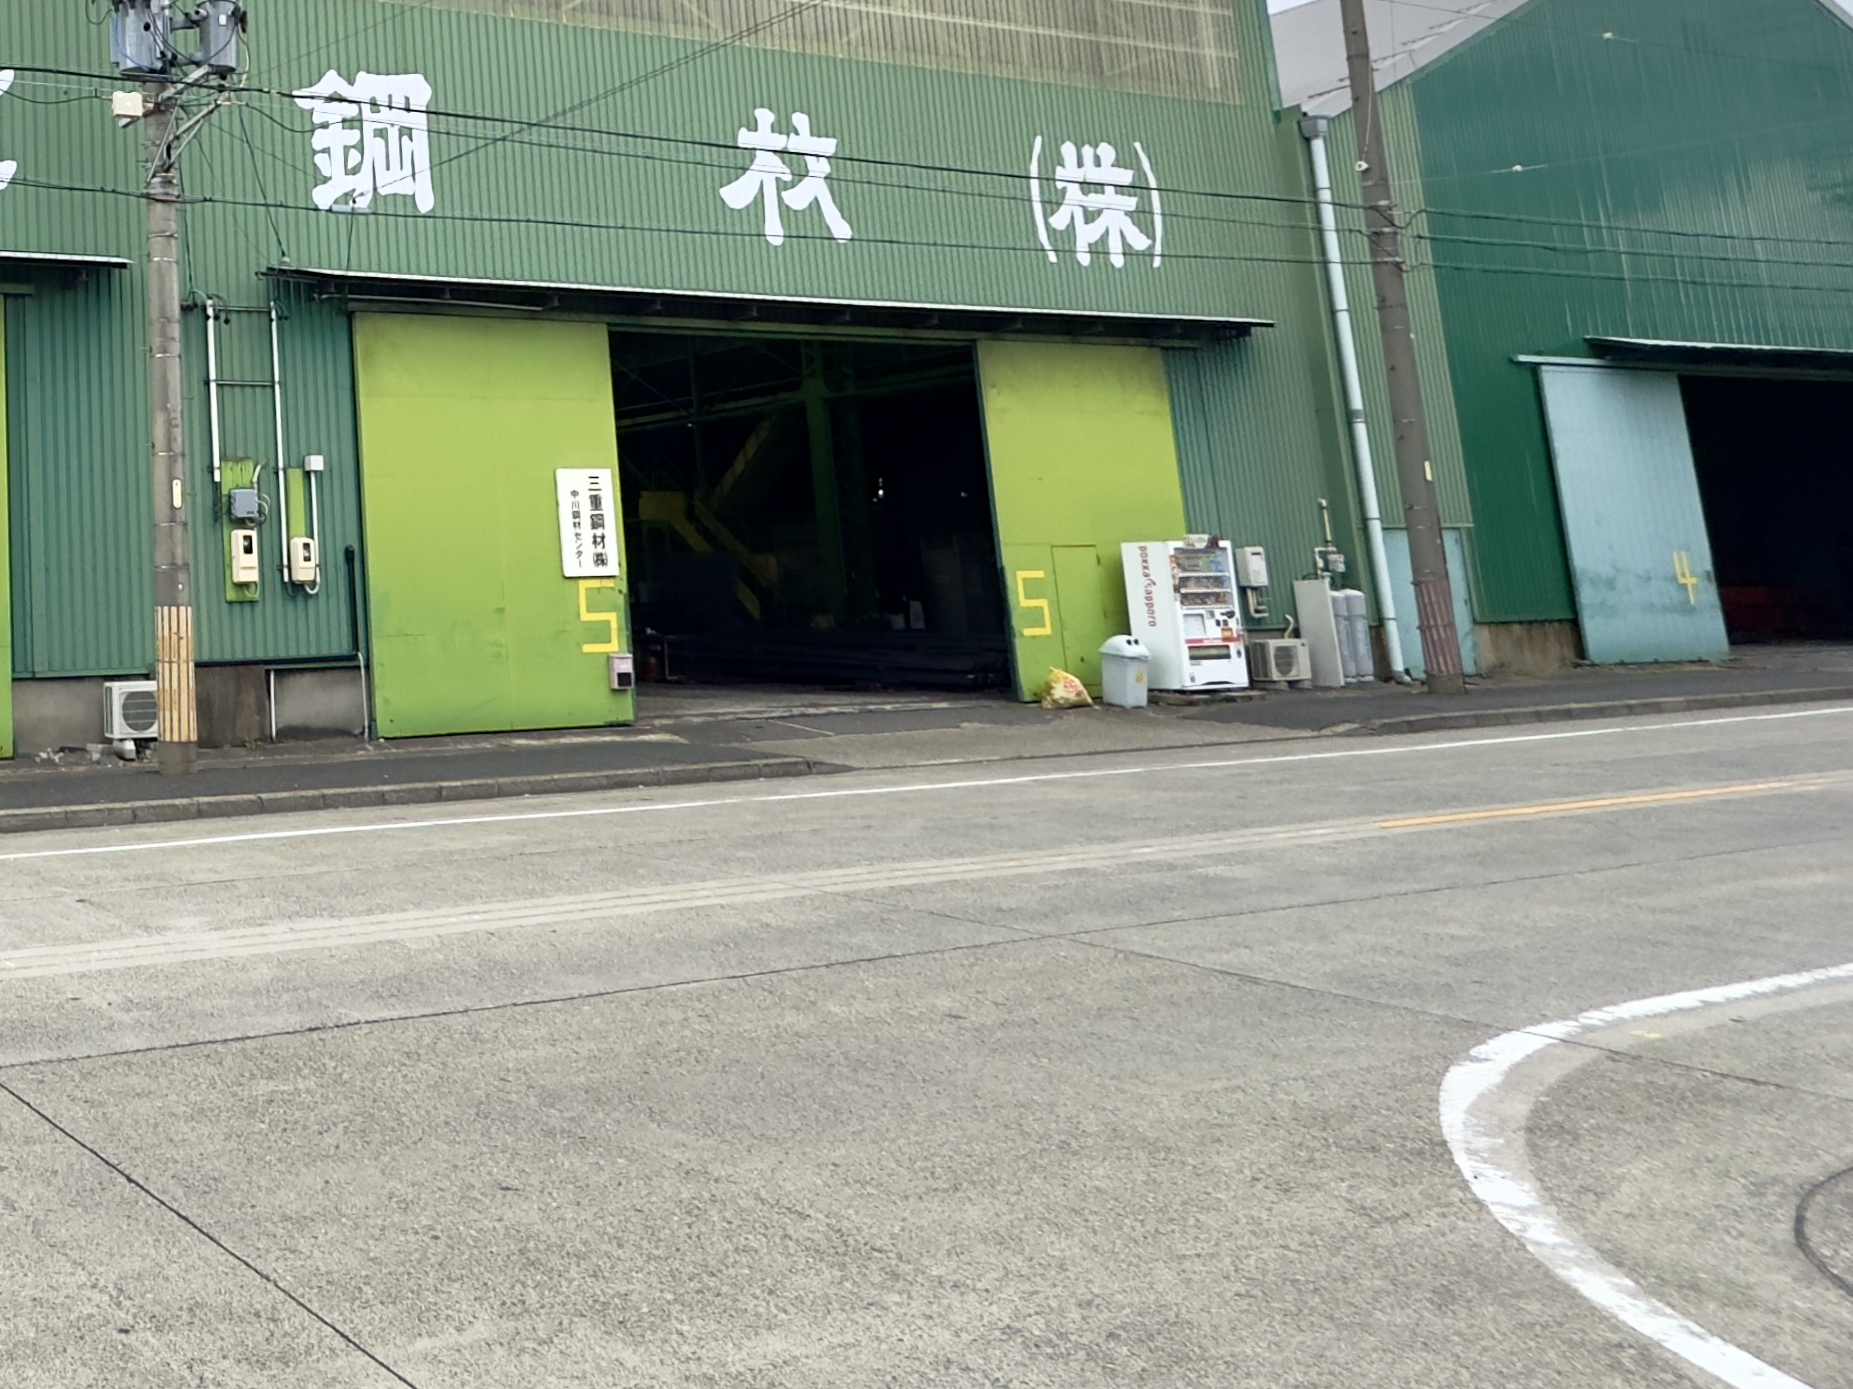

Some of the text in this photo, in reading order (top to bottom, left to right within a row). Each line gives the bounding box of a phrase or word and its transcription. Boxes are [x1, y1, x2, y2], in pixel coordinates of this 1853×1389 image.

[1015, 570, 1052, 636] 5
[1672, 551, 1698, 605] 4
[578, 579, 619, 653] 5
